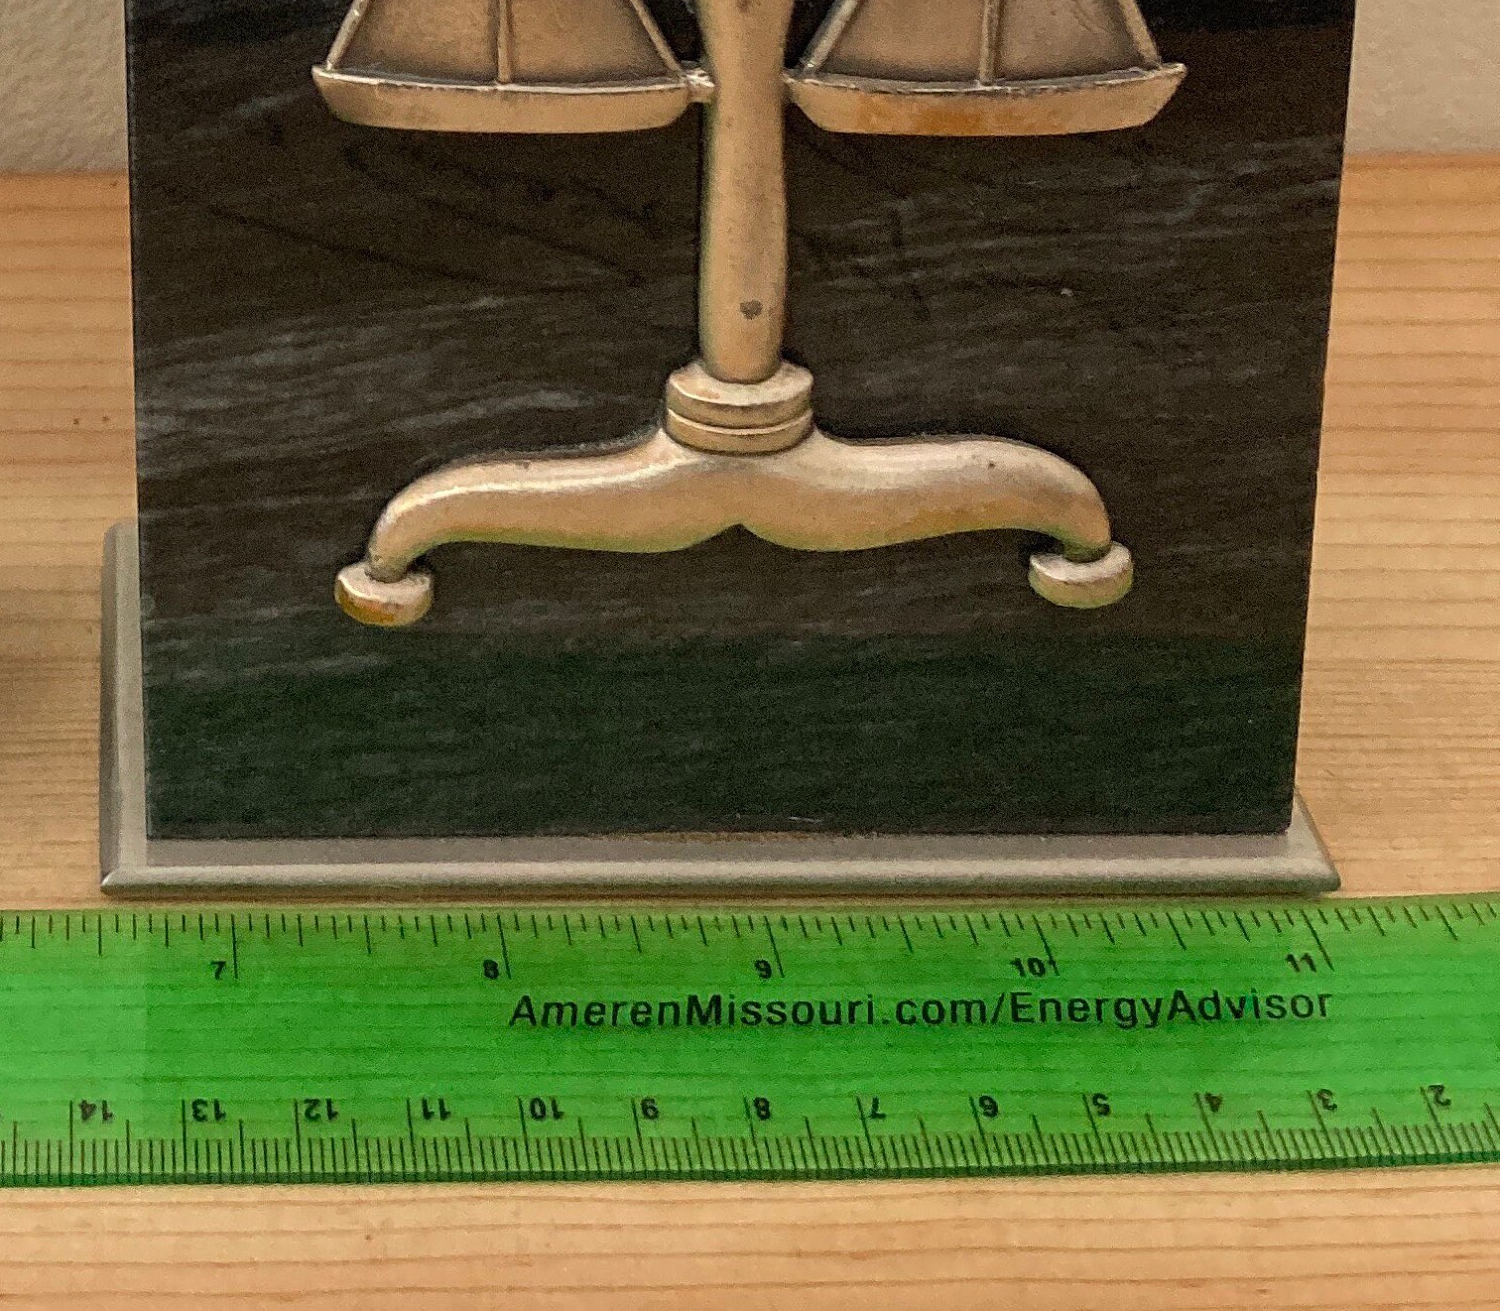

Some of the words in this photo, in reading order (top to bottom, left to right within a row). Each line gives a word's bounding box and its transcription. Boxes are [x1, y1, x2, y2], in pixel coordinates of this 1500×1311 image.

[210, 961, 227, 981] 7
[483, 959, 500, 980] 8
[754, 958, 772, 980] 9
[1010, 956, 1047, 978] 10
[1284, 952, 1318, 974] 11
[508, 988, 1333, 1030] AmerenMissouri.com/EnergyAdvisor
[979, 1094, 999, 1117] 6
[1093, 1093, 1111, 1117] 5
[1204, 1092, 1225, 1113] 4
[1316, 1089, 1338, 1111] 3
[1428, 1084, 1451, 1107] 2
[78, 1099, 114, 1122] 14
[191, 1098, 227, 1121] 13
[303, 1098, 339, 1121] 12
[421, 1098, 451, 1121] 11
[529, 1098, 564, 1121] 10
[641, 1097, 660, 1121] 9
[752, 1097, 772, 1120] 8
[868, 1097, 887, 1120] 7
